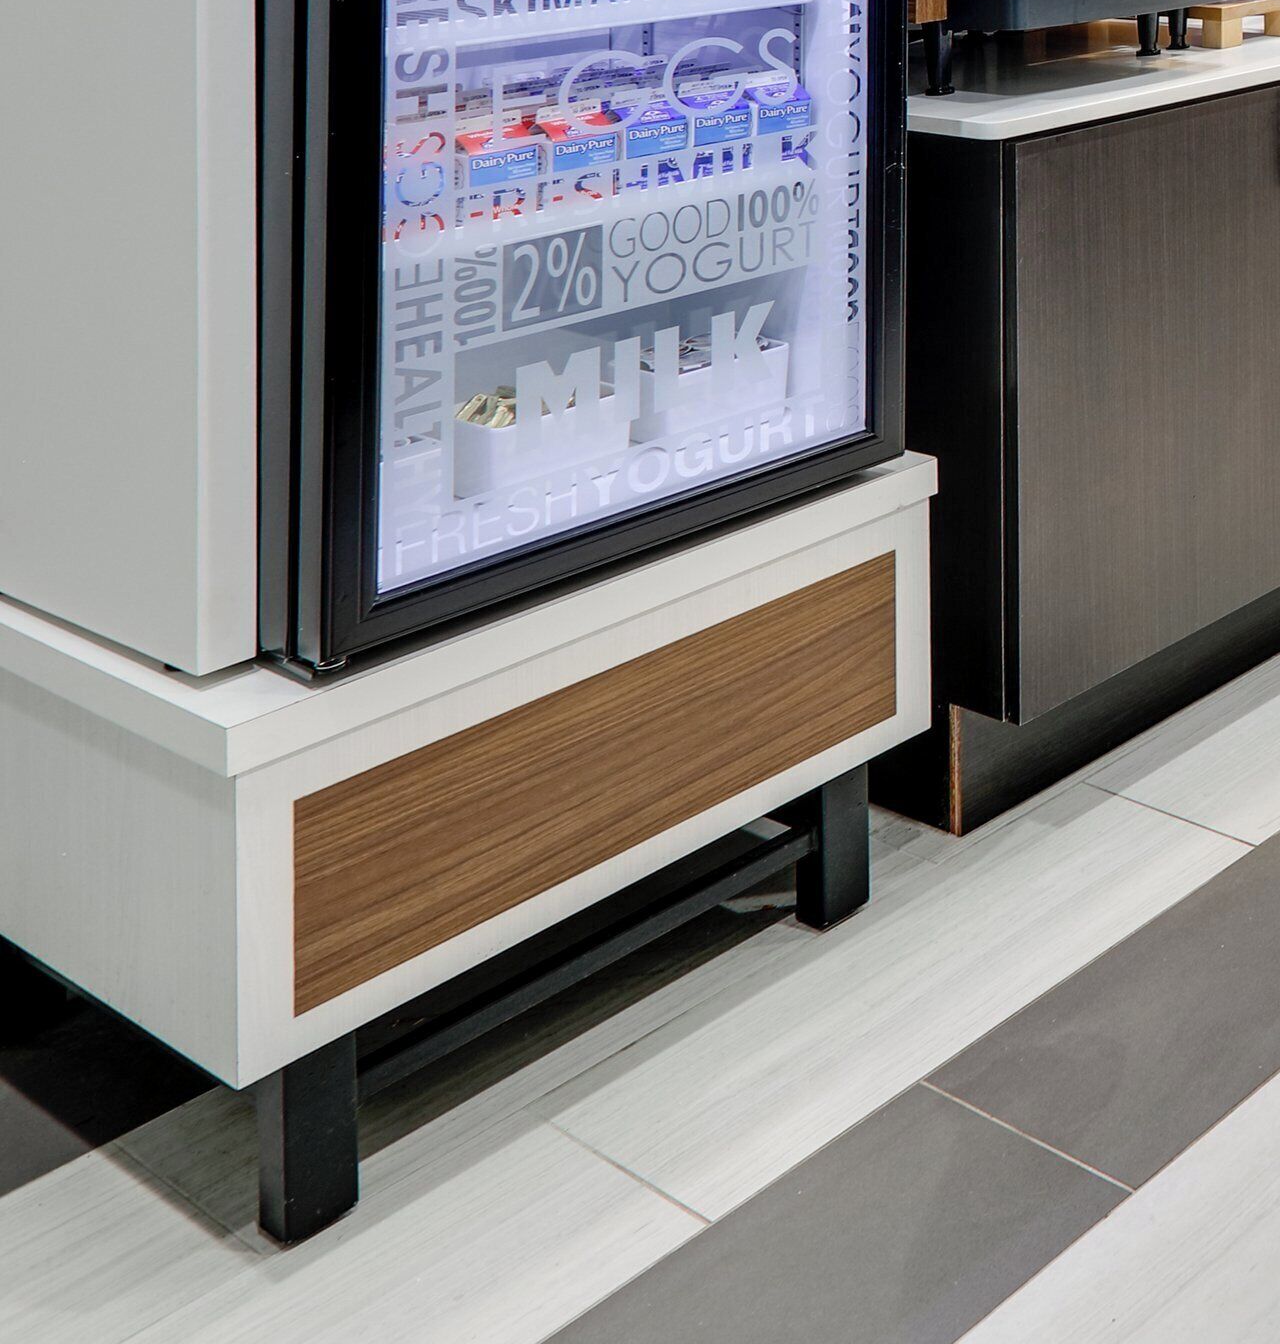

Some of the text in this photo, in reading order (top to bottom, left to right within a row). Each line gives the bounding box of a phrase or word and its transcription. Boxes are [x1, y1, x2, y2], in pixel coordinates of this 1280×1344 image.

[608, 178, 820, 259] GOOD 100%
[611, 220, 817, 303] YOGURT
[453, 244, 498, 347] 100%
[510, 231, 598, 324] 2%
